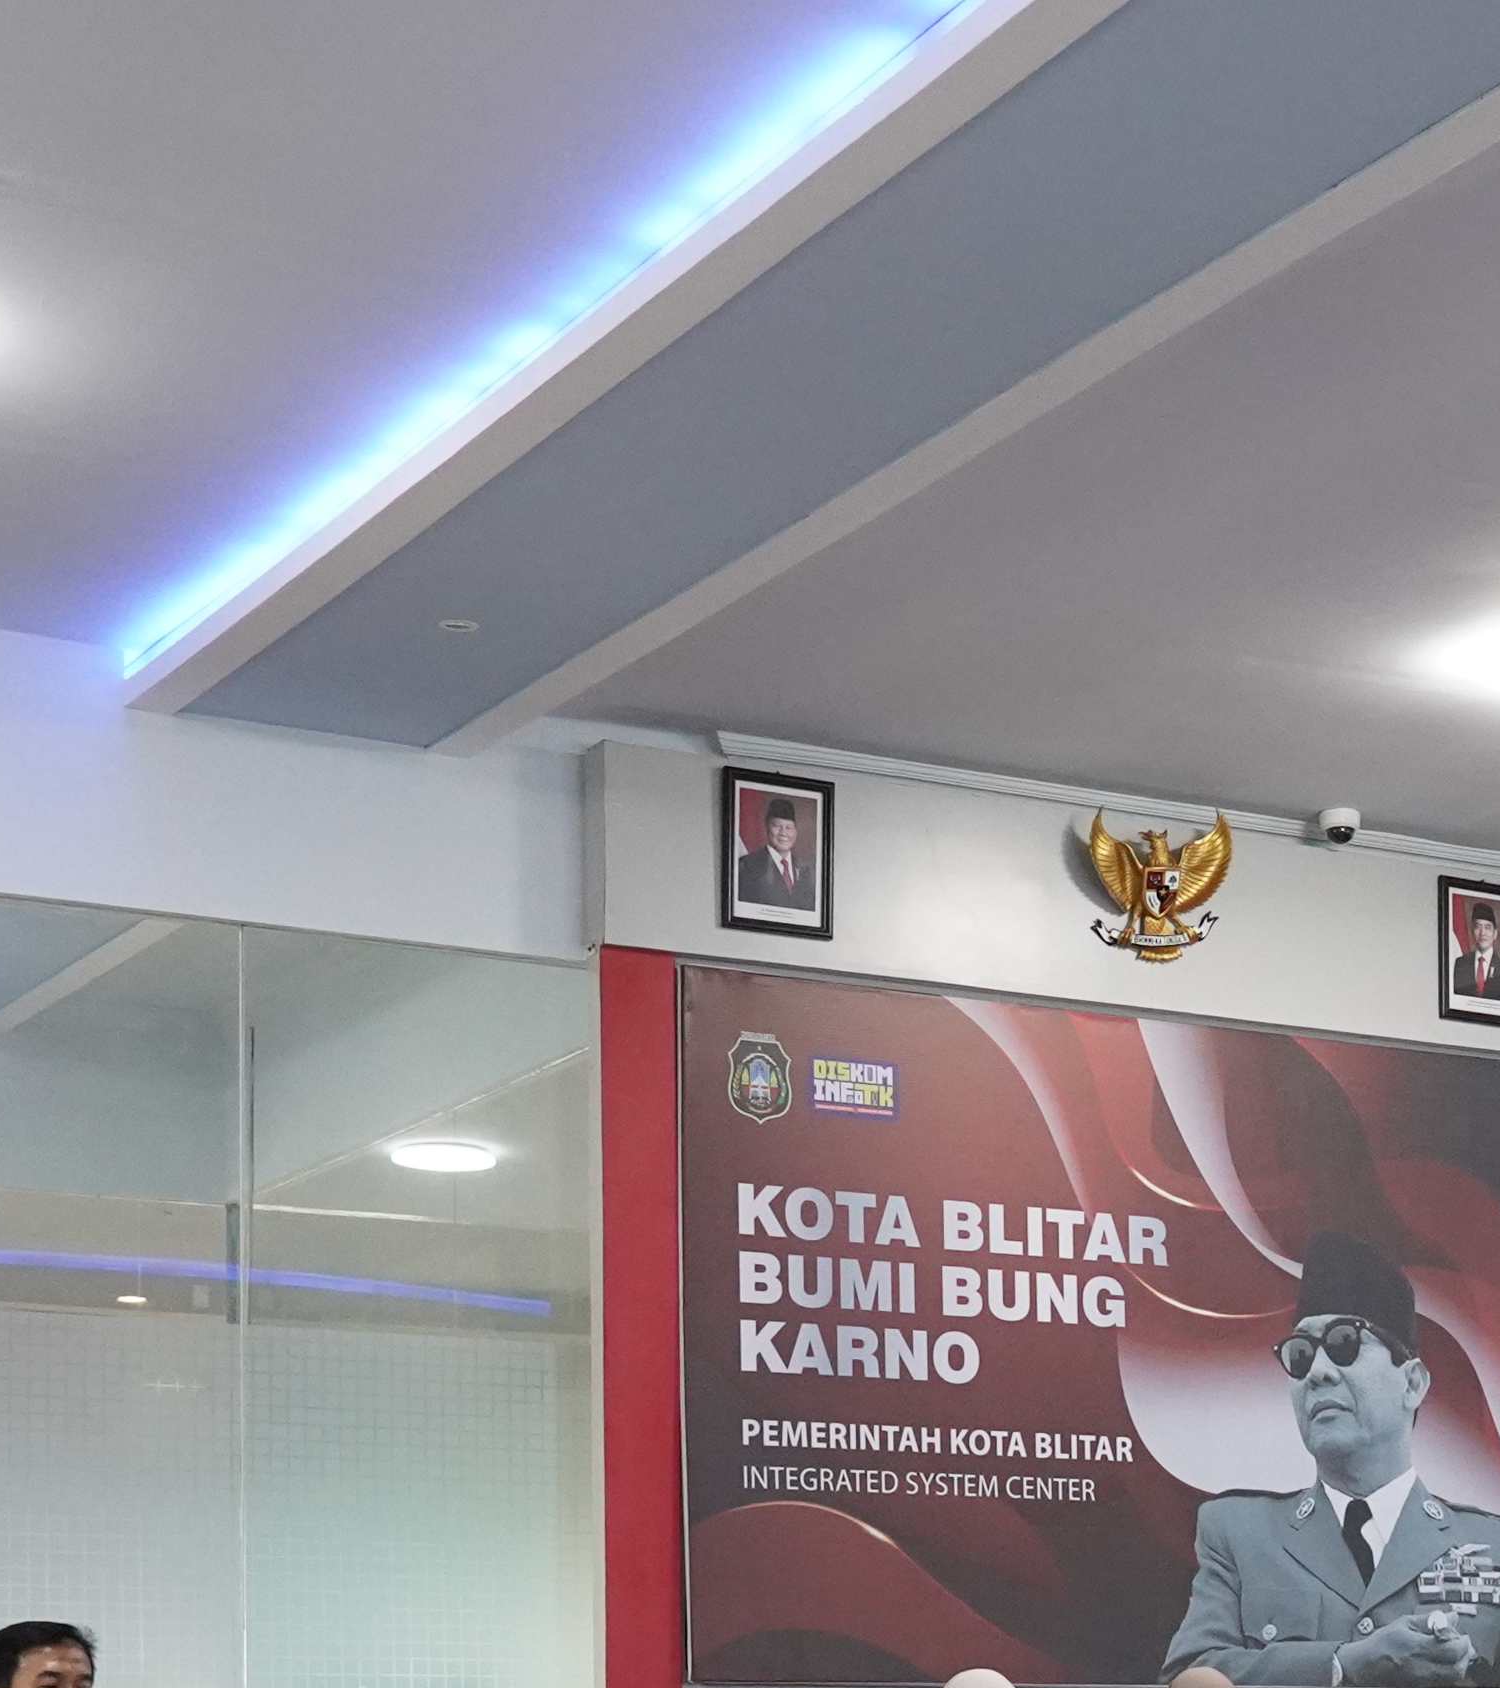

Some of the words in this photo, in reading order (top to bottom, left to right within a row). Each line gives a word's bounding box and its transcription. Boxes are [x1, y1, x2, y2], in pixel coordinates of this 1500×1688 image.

[812, 1058, 894, 1086] DISKOM
[737, 1183, 920, 1249] KOTA
[943, 1201, 1169, 1267] BLITAR
[738, 1251, 917, 1316] BUMI
[942, 1267, 1127, 1328] BUNG
[739, 1319, 981, 1384] KARNO
[741, 1419, 942, 1457] PEMERINTAH
[950, 1428, 1029, 1459] KOTA
[1034, 1433, 1134, 1463] BLITAR
[742, 1465, 899, 1495] INTEGRATED
[905, 1471, 999, 1499] SYSTEM
[1005, 1475, 1097, 1502] CENTER
